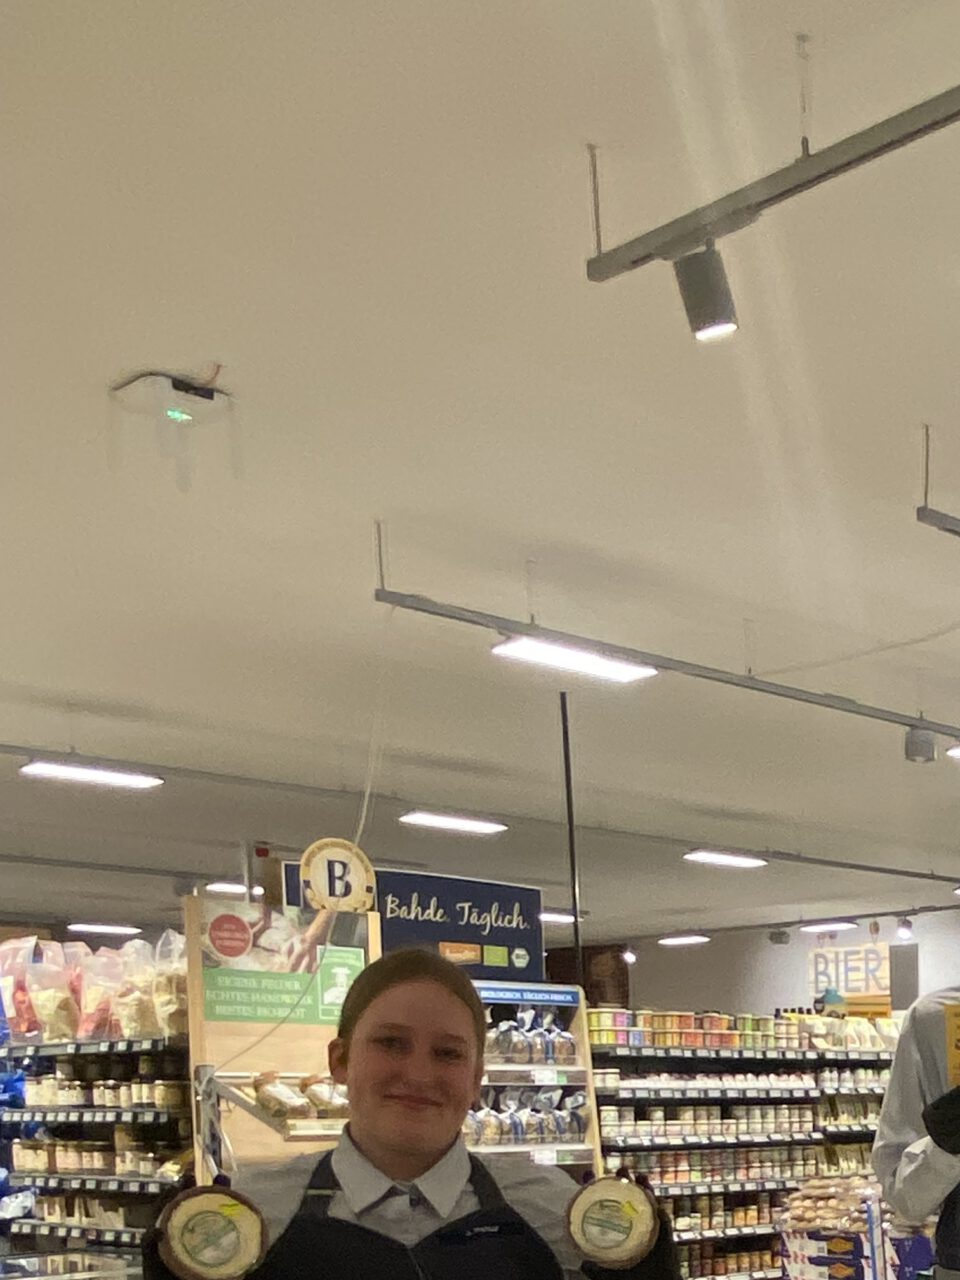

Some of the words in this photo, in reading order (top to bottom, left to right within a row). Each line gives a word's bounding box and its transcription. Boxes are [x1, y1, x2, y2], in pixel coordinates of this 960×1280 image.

[327, 860, 352, 898] B
[456, 901, 531, 936] Täglich.
[814, 949, 890, 994] BIER
